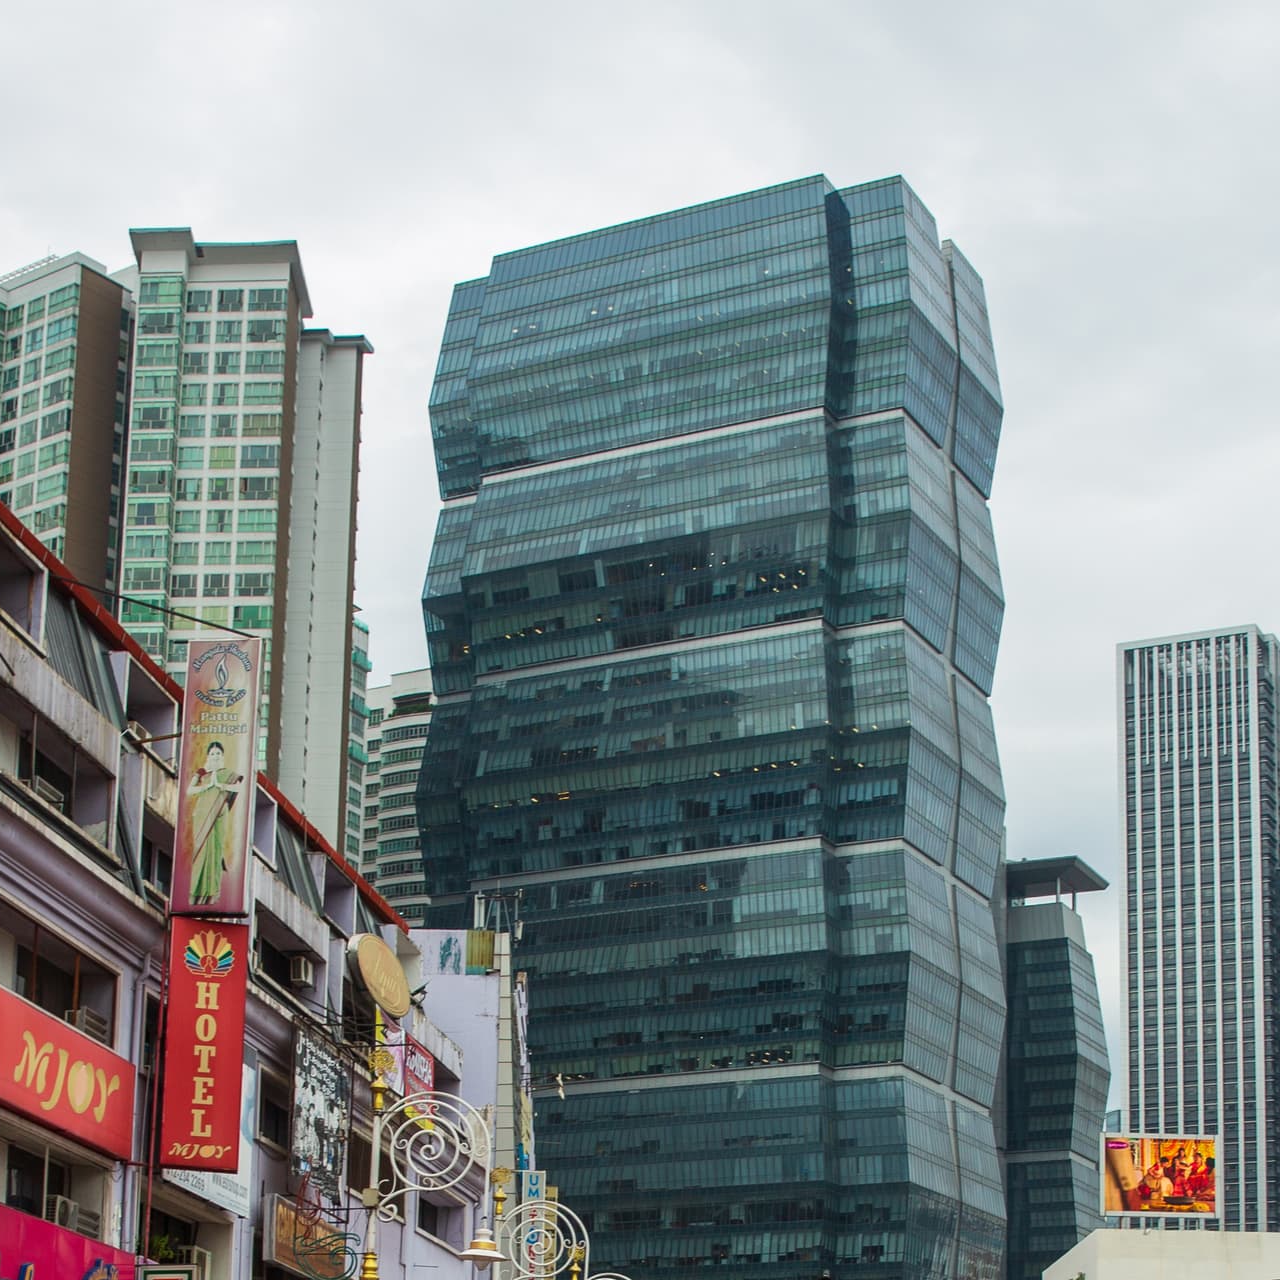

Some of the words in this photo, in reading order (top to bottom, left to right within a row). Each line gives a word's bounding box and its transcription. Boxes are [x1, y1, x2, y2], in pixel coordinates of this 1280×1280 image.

[200, 711, 238, 721] Pattu
[190, 723, 249, 736] Mahligai
[188, 980, 221, 1140] HOTEL
[13, 1029, 121, 1124] MJOY
[167, 1142, 233, 1160] MJOY
